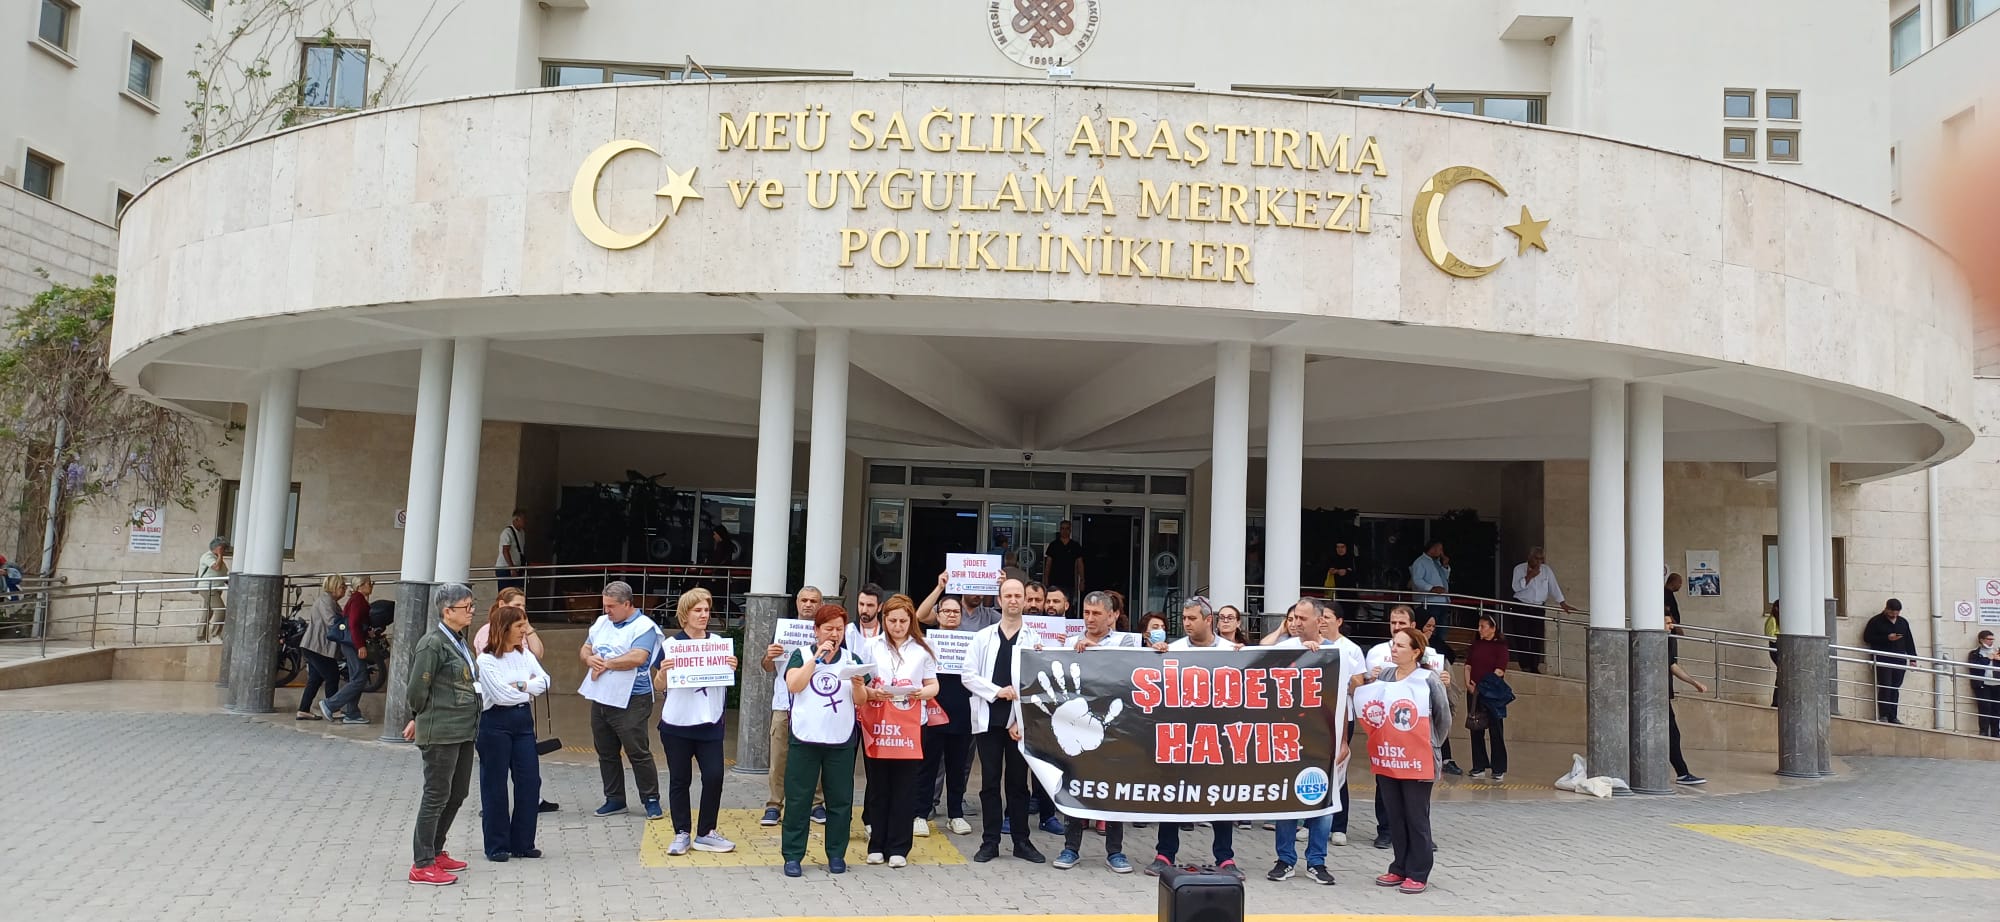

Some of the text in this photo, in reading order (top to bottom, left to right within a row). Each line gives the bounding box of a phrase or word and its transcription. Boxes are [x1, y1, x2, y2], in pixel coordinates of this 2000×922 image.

[717, 103, 1388, 177] MEÜ SAĞLIK ARAŞTIRMA
[727, 168, 1373, 233] ve UYGULAMA MERKEZİ
[838, 221, 1255, 284] POLİKLİNİKLER
[963, 558, 987, 568] ŞİDDETE
[951, 570, 997, 579] SIFIR TOLERANS
[670, 641, 729, 654] SAĞLIKTA EĞİTİMDE
[1131, 659, 1322, 714] ŞİDDETE
[873, 719, 902, 736] DİSK
[1155, 721, 1303, 764] HAYIR
[1377, 741, 1406, 758] DİSK
[1381, 757, 1422, 772] SAĞLIK-İŞ
[1069, 778, 1289, 806] SES MERSİN ŞUBESİ
[1296, 783, 1328, 794] KESK
